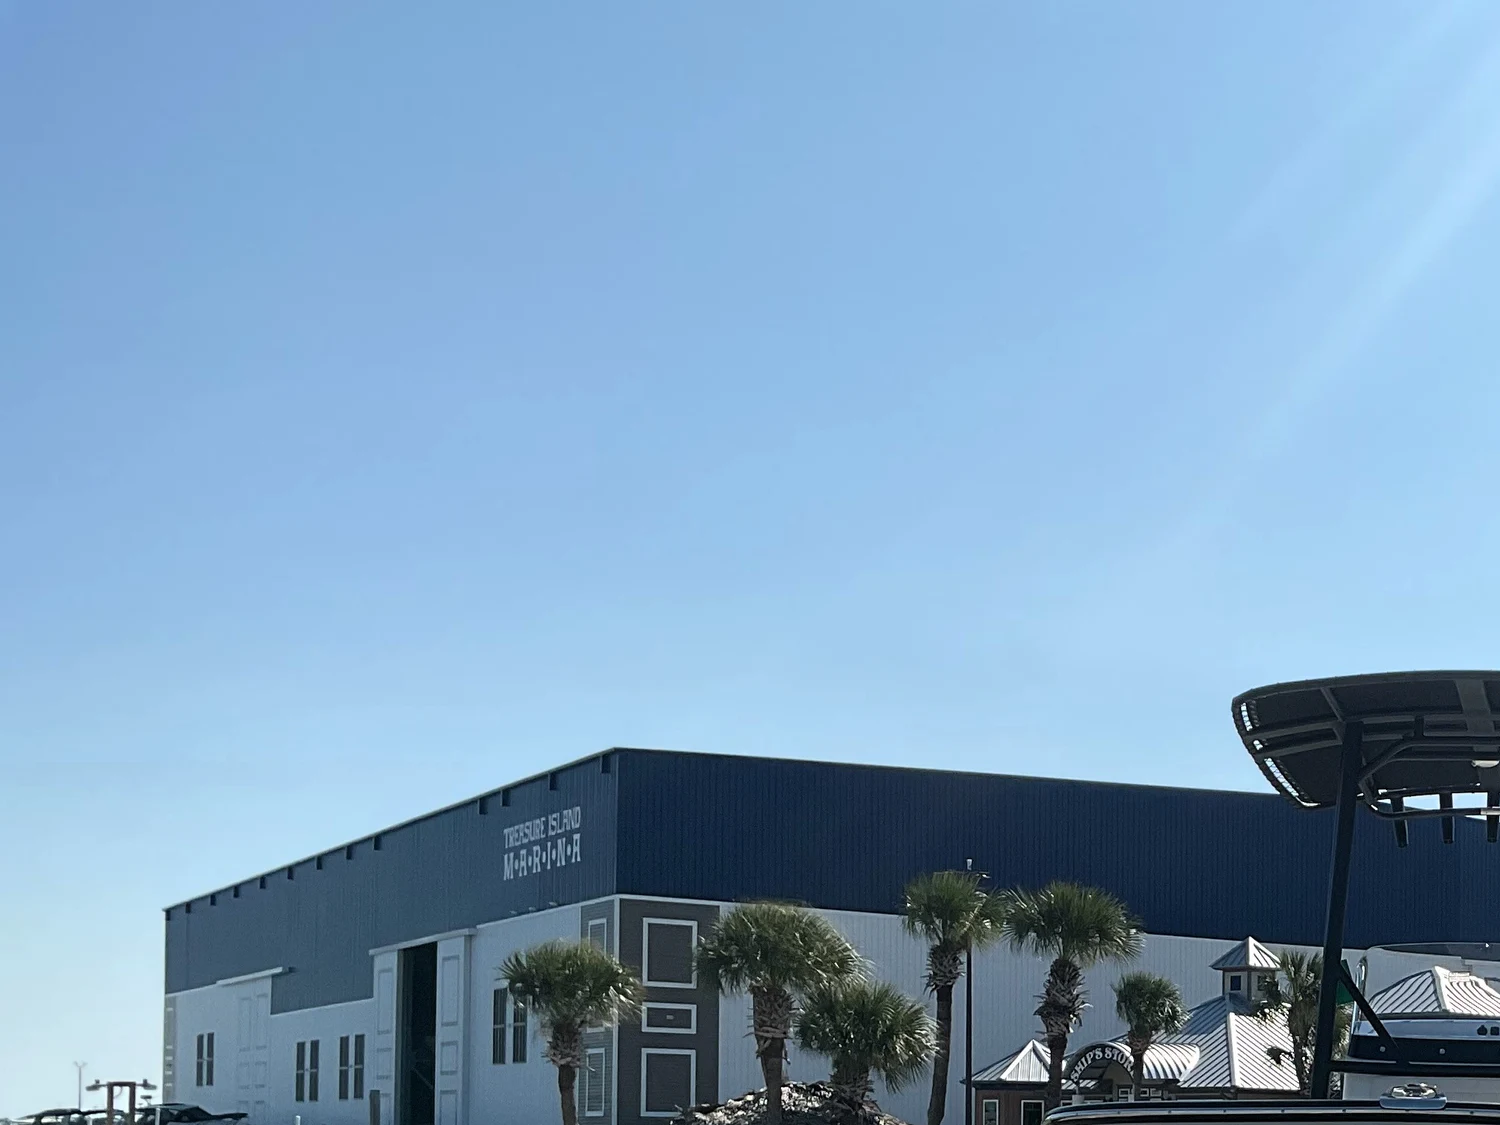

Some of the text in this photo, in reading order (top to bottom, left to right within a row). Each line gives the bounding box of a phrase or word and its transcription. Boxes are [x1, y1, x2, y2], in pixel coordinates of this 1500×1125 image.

[503, 806, 581, 849] TREASURE ISLAND
[1070, 1047, 1103, 1083] SHIP'S
